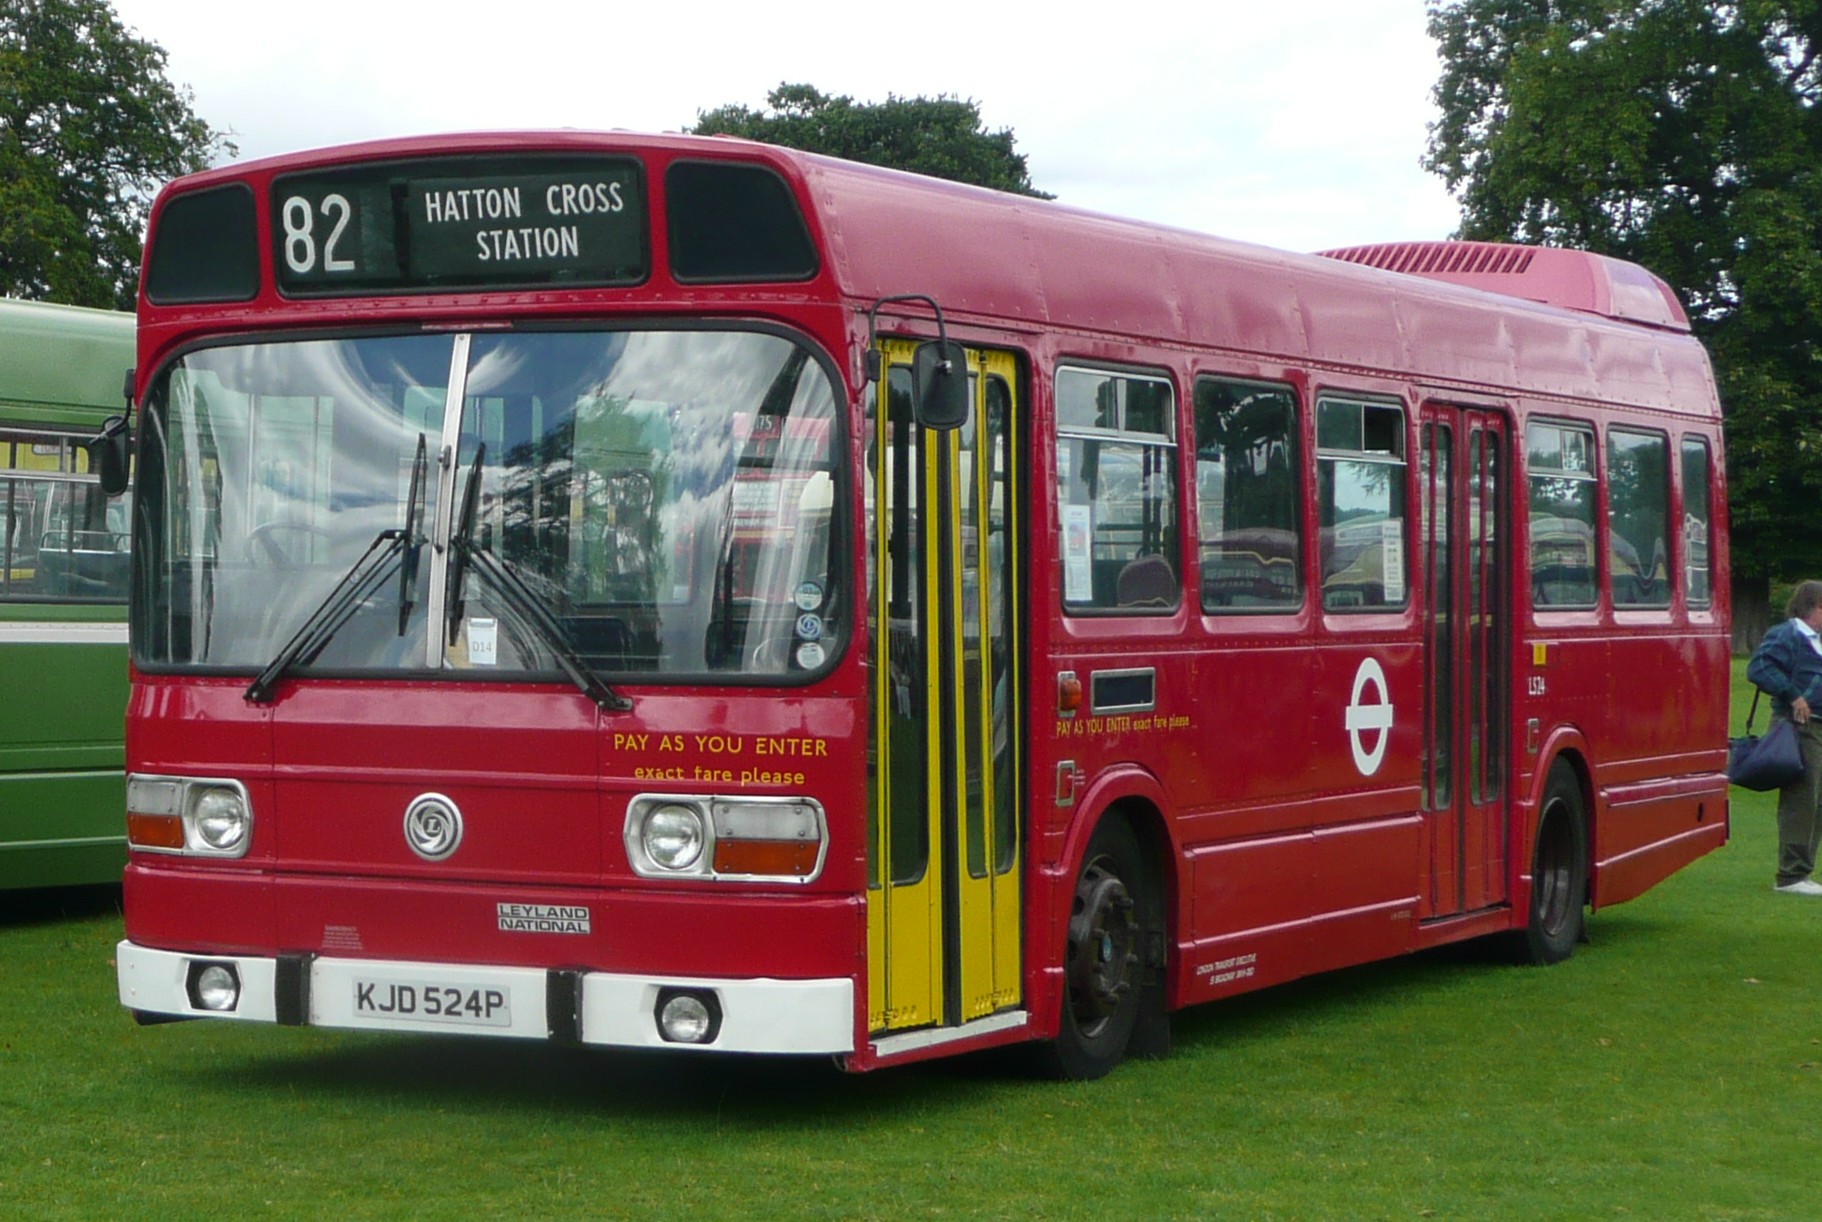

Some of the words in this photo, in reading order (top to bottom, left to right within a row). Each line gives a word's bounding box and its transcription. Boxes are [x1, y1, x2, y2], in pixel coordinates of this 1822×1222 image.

[425, 187, 521, 222] HATTON
[546, 182, 624, 216] CROSS
[282, 193, 355, 273] 82
[476, 226, 579, 260] STATION
[472, 641, 492, 653] D14
[1056, 720, 1071, 738] PAY
[1074, 718, 1084, 735] AS
[1086, 718, 1103, 734] YOU
[1106, 715, 1131, 733] ENTER
[614, 733, 649, 750] PAY
[659, 735, 685, 752] AS
[695, 735, 743, 753] YOU
[755, 737, 828, 756] ENTER
[634, 766, 684, 780] exact
[694, 765, 733, 782] fare
[741, 766, 805, 786] please
[500, 904, 587, 919] LEYLAND
[500, 918, 588, 933] NATIONAL
[357, 982, 417, 1013] KJD
[423, 986, 504, 1018] 524P
